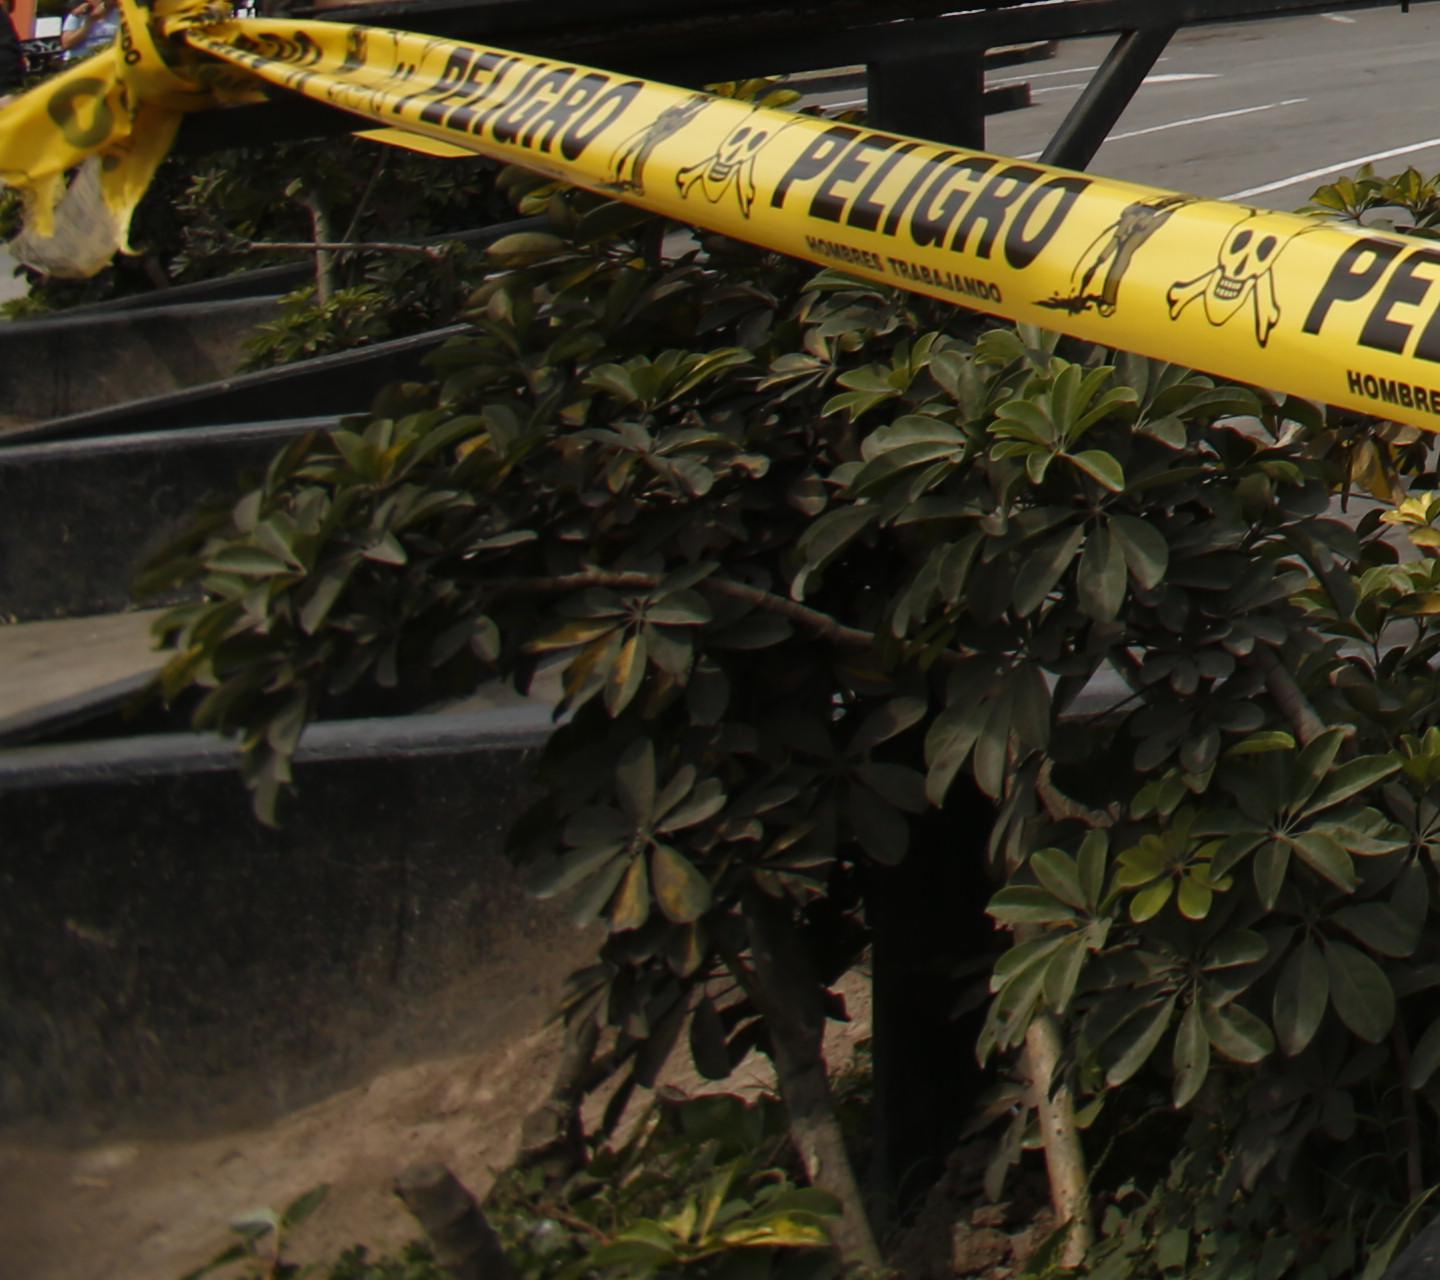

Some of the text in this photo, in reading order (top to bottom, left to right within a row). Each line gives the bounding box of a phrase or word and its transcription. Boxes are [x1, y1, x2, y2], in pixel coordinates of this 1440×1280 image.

[420, 46, 645, 162] PELIGRO
[769, 125, 1094, 270] PELIGRO
[805, 234, 1003, 303] HOMBRES TRABAJANDO
